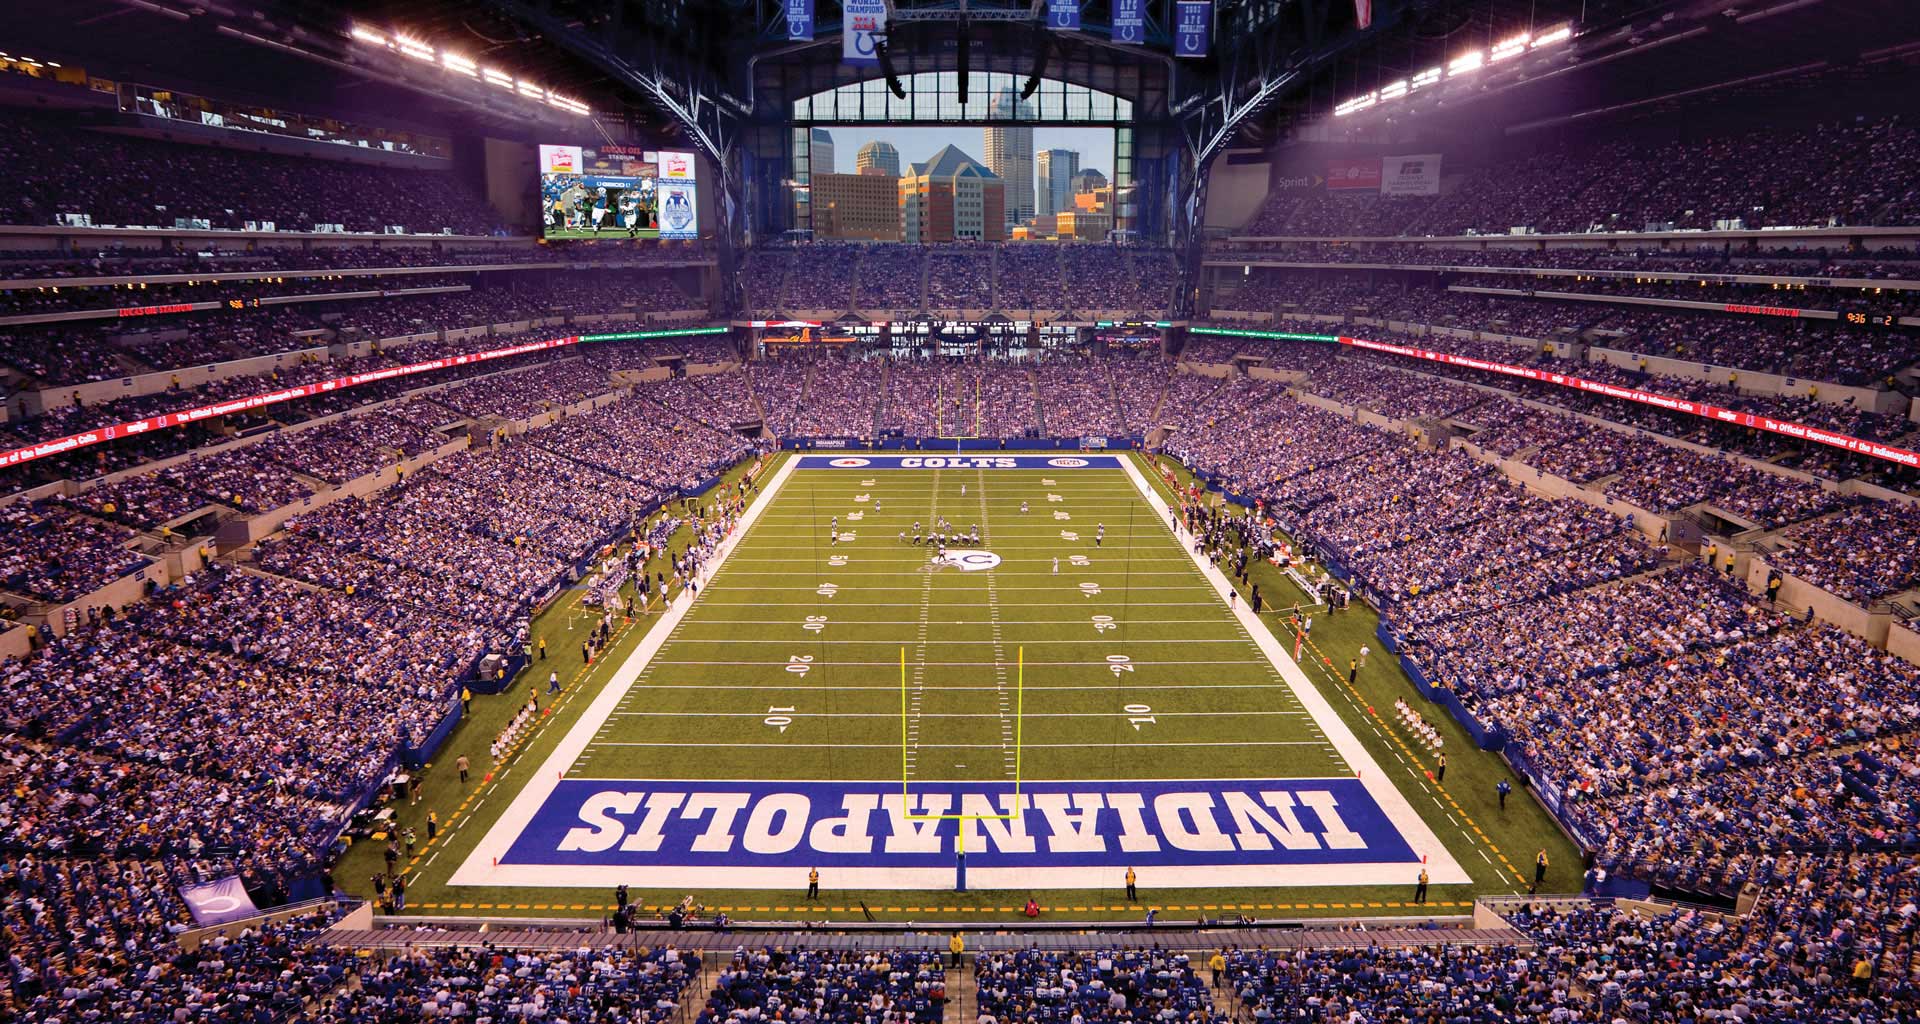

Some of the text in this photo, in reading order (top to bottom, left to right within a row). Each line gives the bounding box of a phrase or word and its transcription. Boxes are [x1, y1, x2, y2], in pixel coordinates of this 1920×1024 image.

[846, 5, 884, 14] CHAMPIONS
[1279, 176, 1309, 190] Sprint
[159, 303, 193, 314] STADIUM
[1725, 303, 1747, 313] LUCAS
[1761, 307, 1801, 317] STADIUM
[1847, 312, 1866, 324] 9:36
[1884, 315, 1893, 326] 2
[9, 451, 19, 462] of
[20, 450, 34, 460] the
[78, 434, 98, 444] Colts
[1765, 420, 1918, 465] The Official Supercenter of the Indianapolis
[900, 457, 1018, 468] COLTS
[816, 582, 839, 595] 40
[1079, 582, 1102, 595] 40
[802, 615, 828, 630] 30
[1091, 615, 1117, 630] 30
[785, 655, 814, 673] 20
[1106, 655, 1135, 672] 20
[764, 705, 796, 726] 10
[1124, 704, 1157, 724] 10
[556, 789, 1369, 855] INDIANAPOLIS
